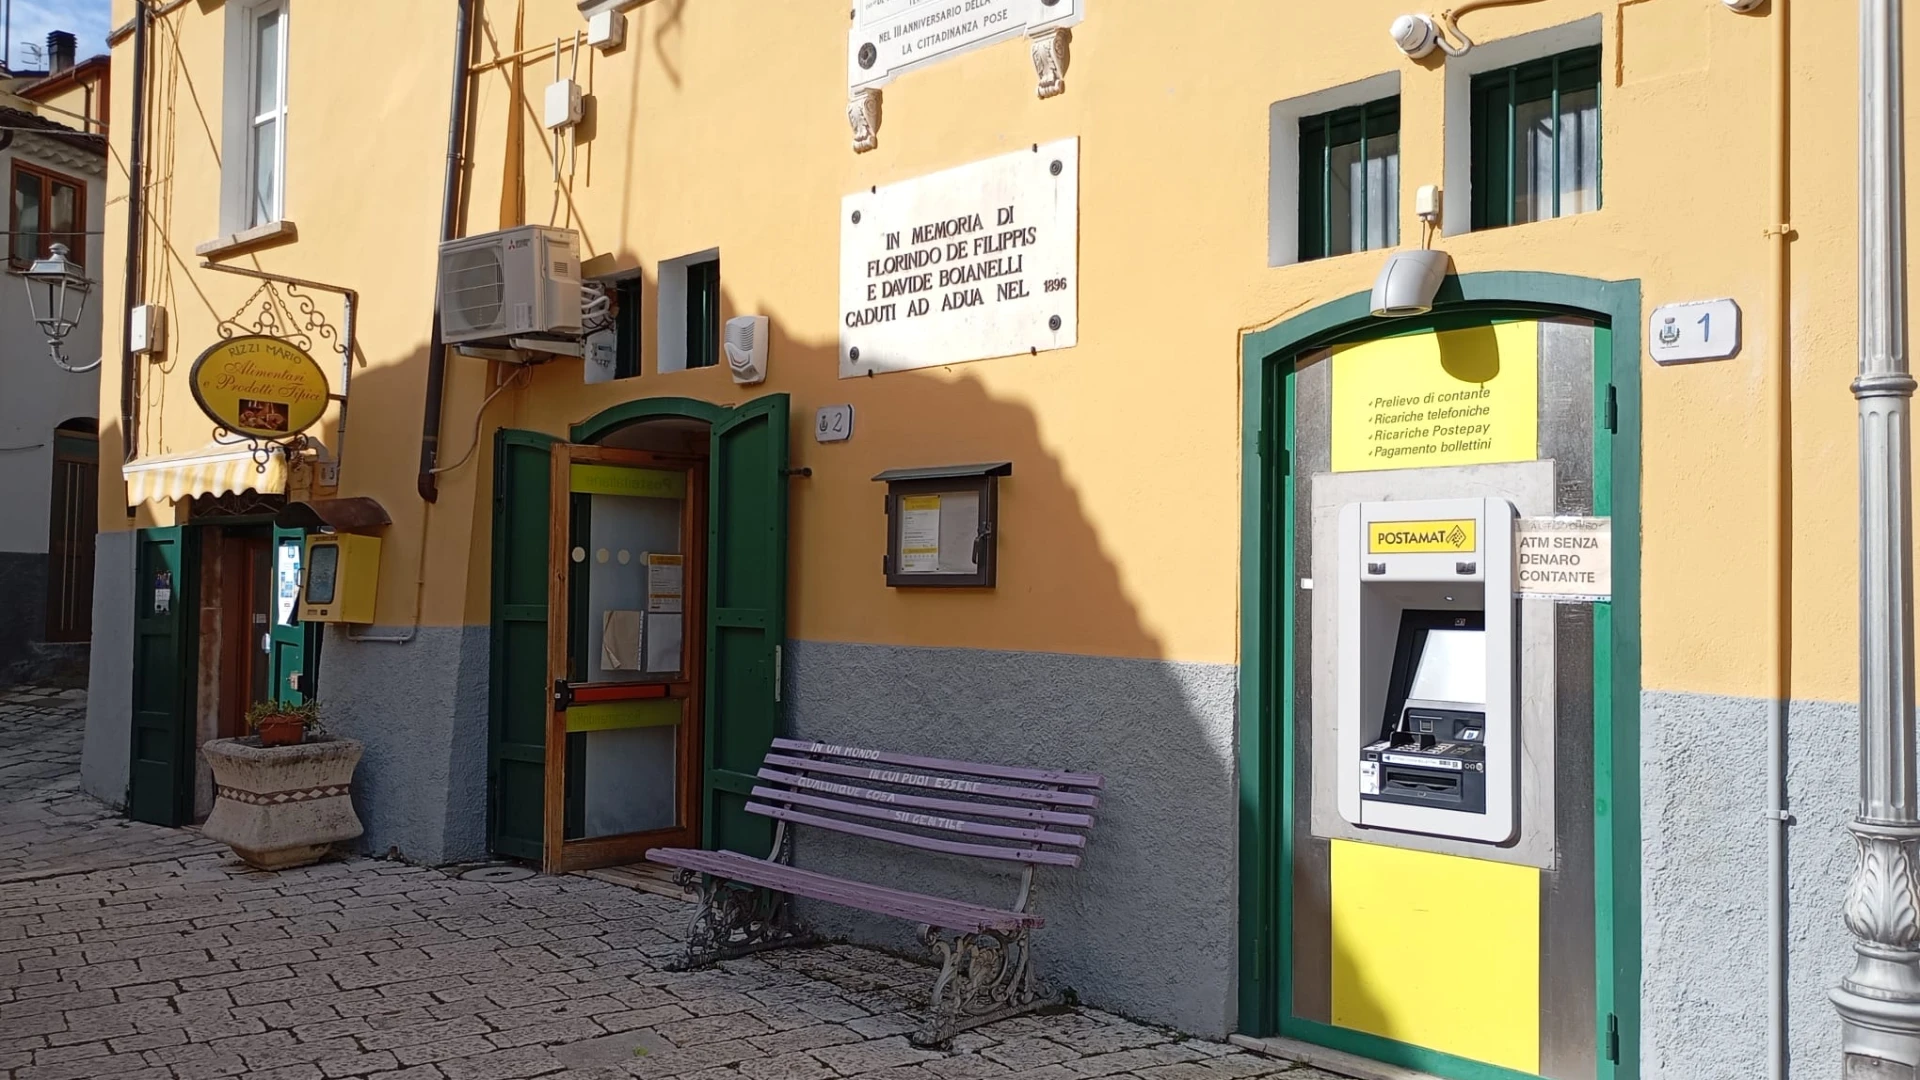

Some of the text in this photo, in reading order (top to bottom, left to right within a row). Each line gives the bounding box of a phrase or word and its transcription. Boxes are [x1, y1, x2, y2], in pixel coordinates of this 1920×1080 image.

[878, 30, 891, 43] NEL
[894, 25, 902, 38] III
[902, 5, 961, 35] ANNIVERSARIO
[902, 8, 1008, 56] LA CITTADINANZA POSE
[886, 205, 1015, 250] IN MEMORIA DI
[867, 227, 1037, 278] FLORINDO DE FILIPPIS
[867, 254, 1023, 301] E DAVIDE BOIANELLI
[845, 277, 1067, 328] CADUTI AD ADUA NEL 1896
[1696, 312, 1710, 342] 1
[228, 343, 302, 365] RIZZI MARIO
[224, 360, 306, 383] Alimentari
[216, 374, 275, 396] Prodotti
[278, 382, 321, 404] Tipici
[1374, 388, 1491, 409] Prelievo di contante
[832, 412, 842, 432] 2
[1374, 405, 1490, 425] Ricariche telefoniche
[1374, 423, 1491, 441] Ricariche Postepay
[1374, 437, 1492, 459] Pagamento bollettini
[1378, 530, 1446, 545] POSTAMAT
[1520, 536, 1599, 549] ATM SENZA
[1520, 554, 1581, 566] DENARO
[1519, 570, 1595, 583] CONTANTE
[810, 742, 880, 760] IN UN MONDO
[797, 776, 896, 803] QUALUNQUE COSA
[868, 769, 981, 793] IN CUI PUOI ESSERE
[911, 814, 966, 831] GENTILE
